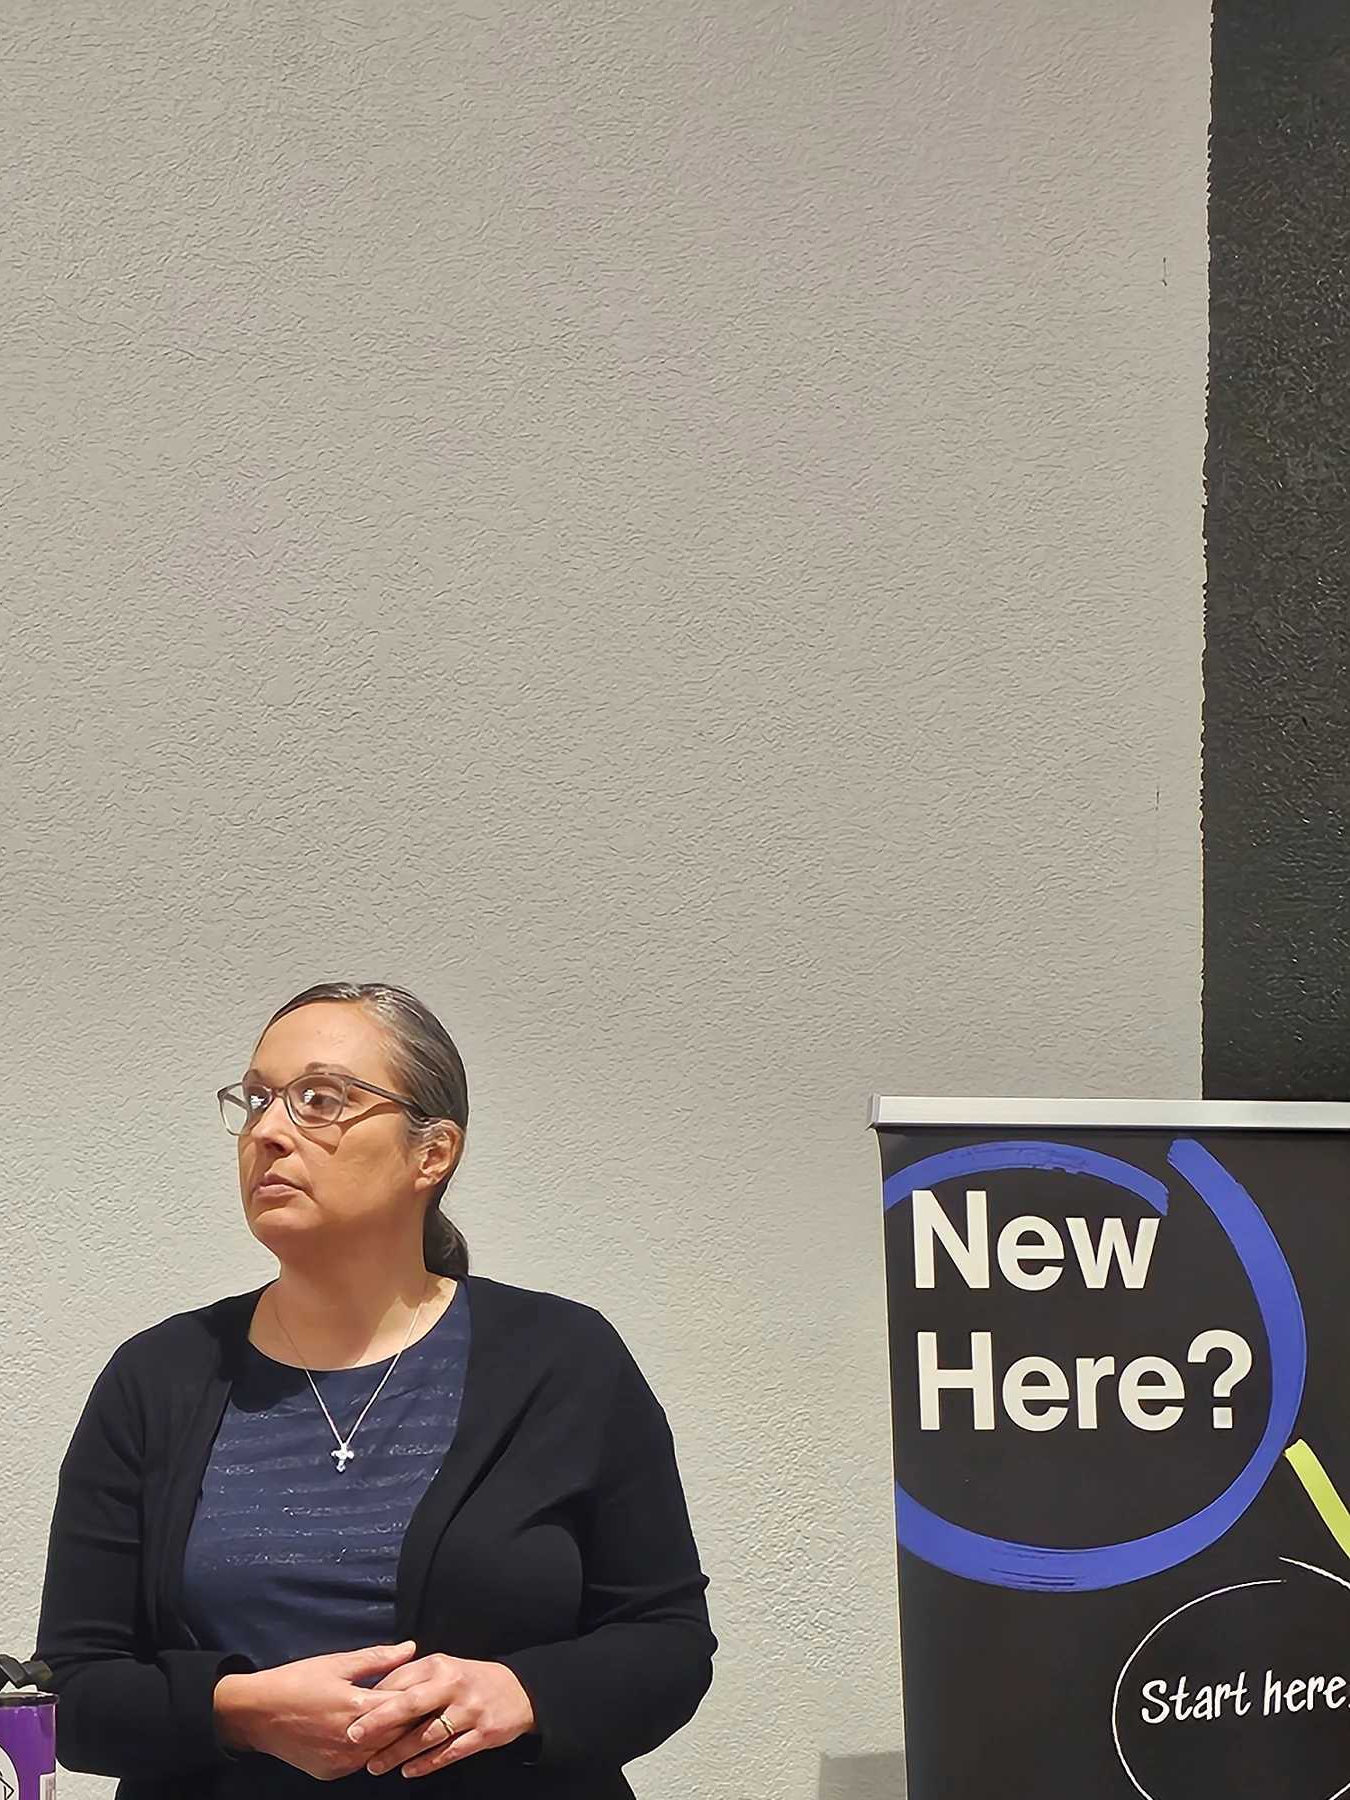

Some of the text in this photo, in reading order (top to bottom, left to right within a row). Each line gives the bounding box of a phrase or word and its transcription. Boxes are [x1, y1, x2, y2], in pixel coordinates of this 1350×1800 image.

[911, 1190, 1160, 1290] New
[916, 1328, 1253, 1432] Here?
[1141, 1669, 1350, 1725] Start here
